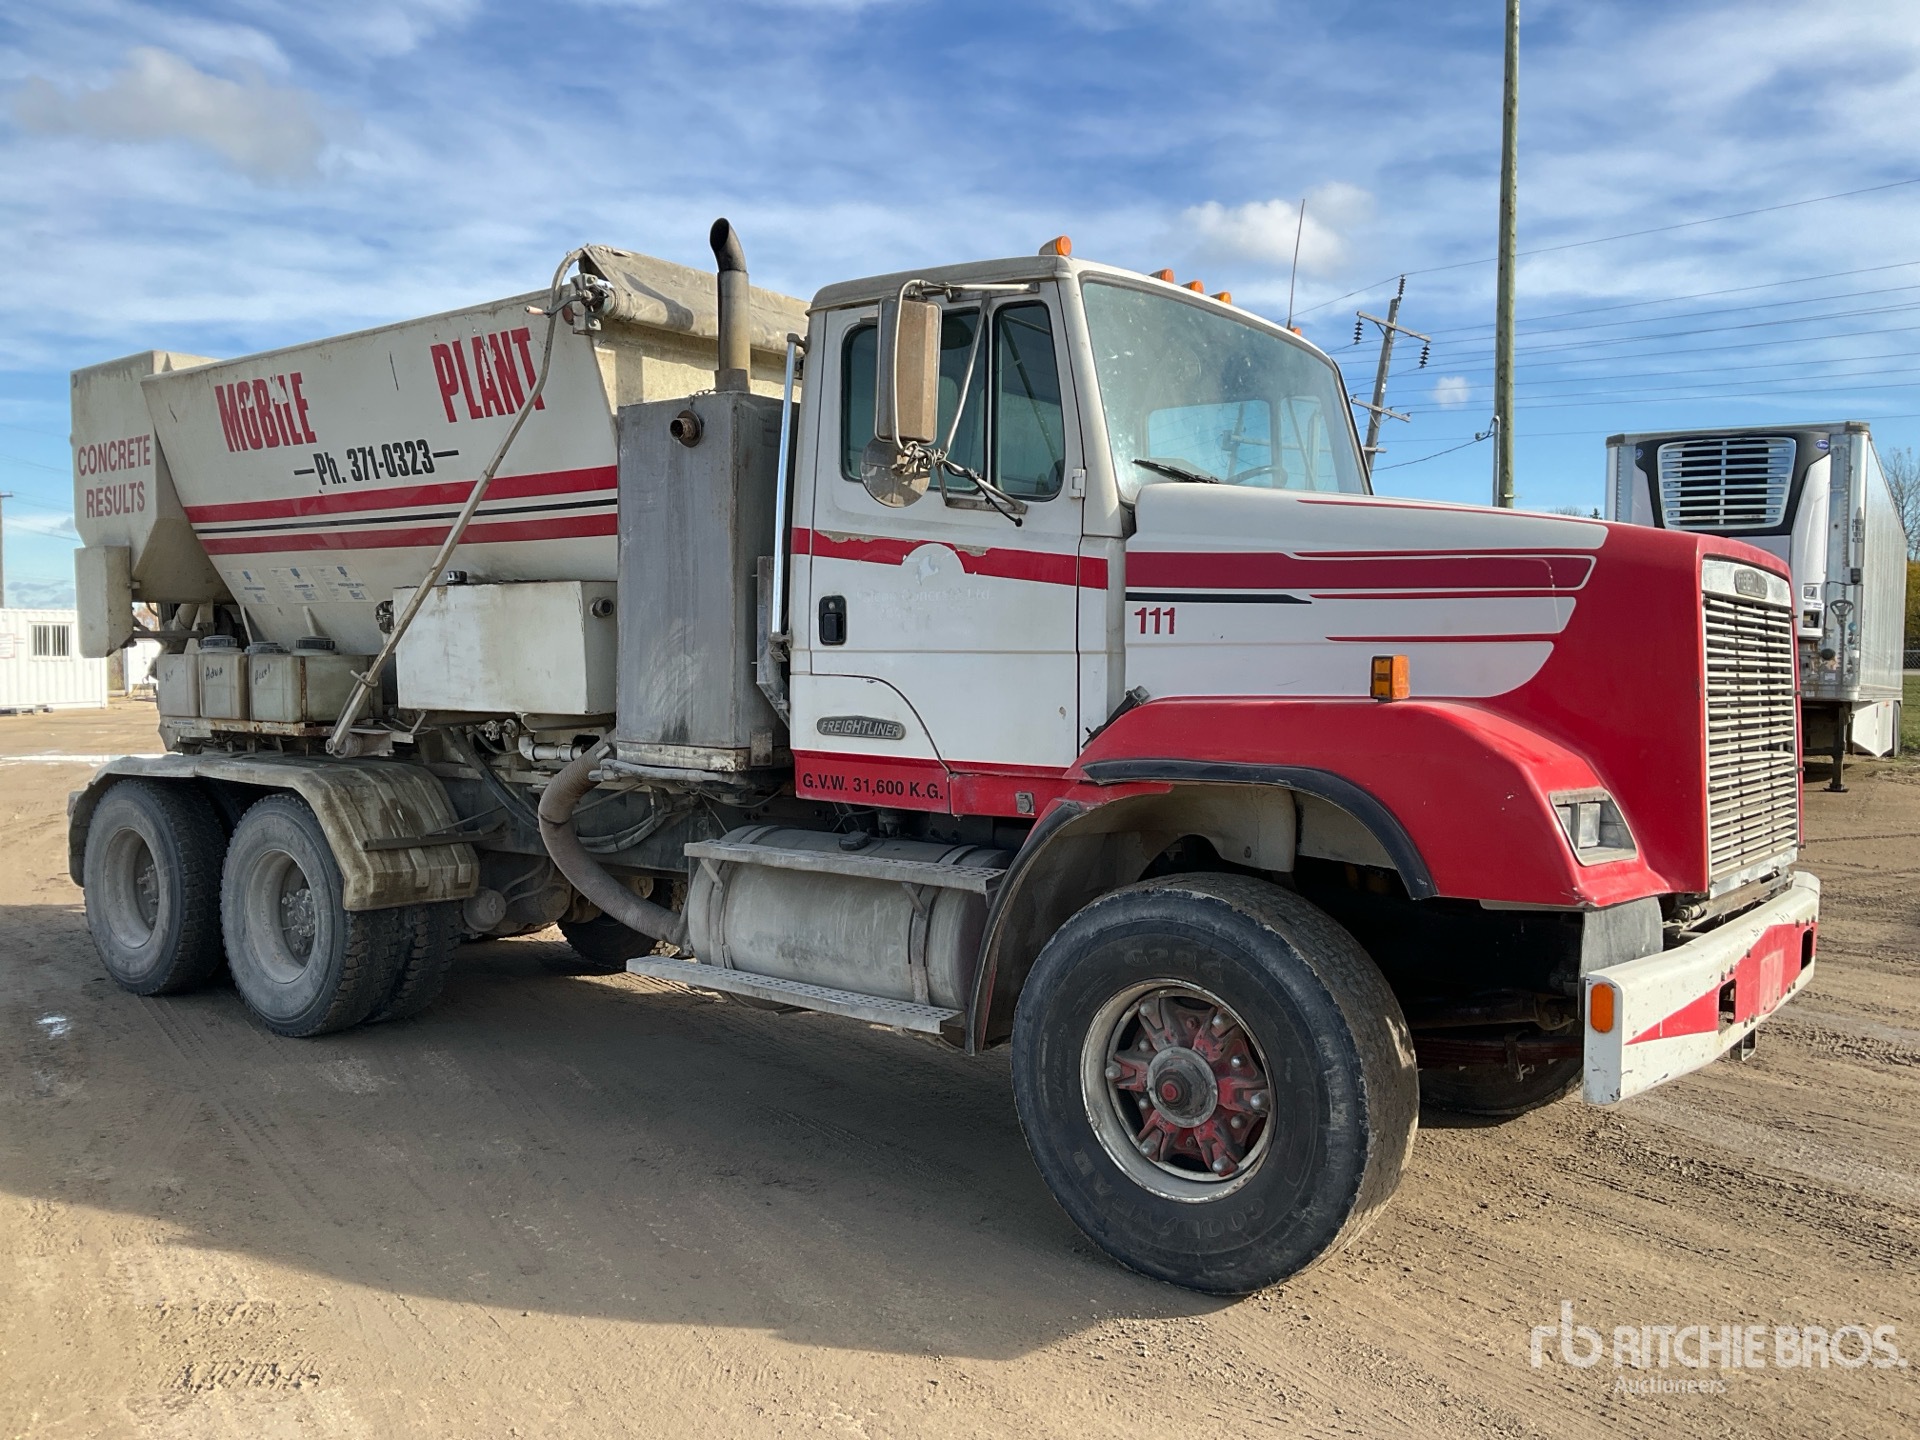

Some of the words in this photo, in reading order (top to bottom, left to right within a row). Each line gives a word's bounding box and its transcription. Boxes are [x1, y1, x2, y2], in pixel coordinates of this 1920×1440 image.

[214, 372, 317, 453] MOBILE
[430, 327, 545, 423] PLANT
[78, 434, 151, 476] CONCRETE
[86, 480, 146, 519] RESULTS
[1134, 607, 1176, 635] 111
[820, 719, 900, 737] FREIGHTLINER
[802, 772, 849, 792] G.V.W.
[853, 778, 905, 797] 31,600
[909, 781, 944, 799] K.G.
